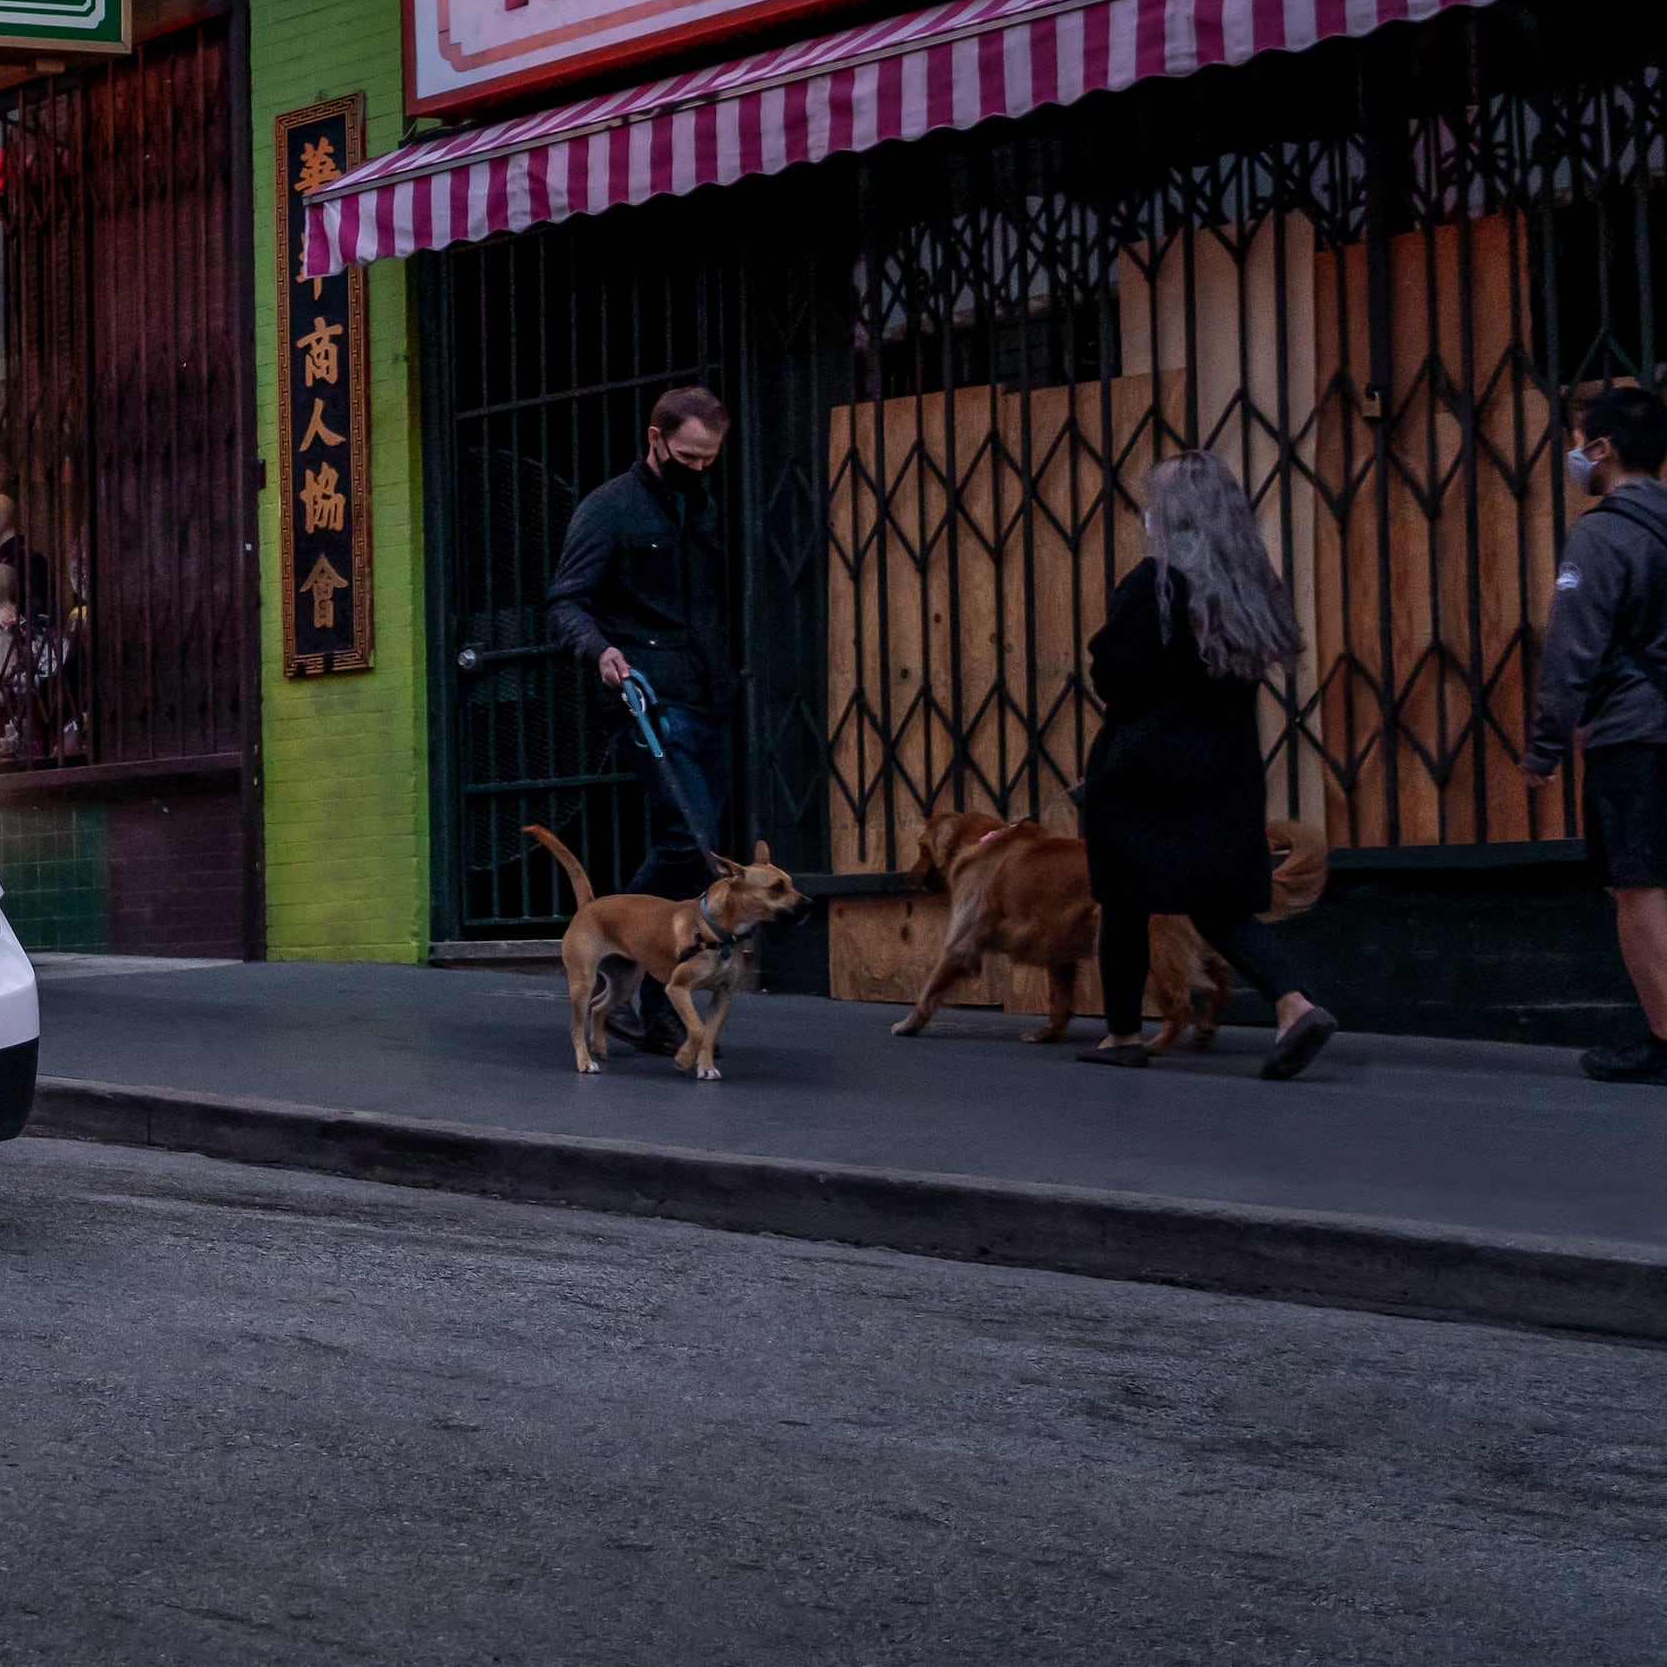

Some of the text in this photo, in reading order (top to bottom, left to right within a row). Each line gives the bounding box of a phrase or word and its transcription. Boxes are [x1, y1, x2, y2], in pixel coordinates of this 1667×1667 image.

[294, 136, 349, 629] 華商人協會
